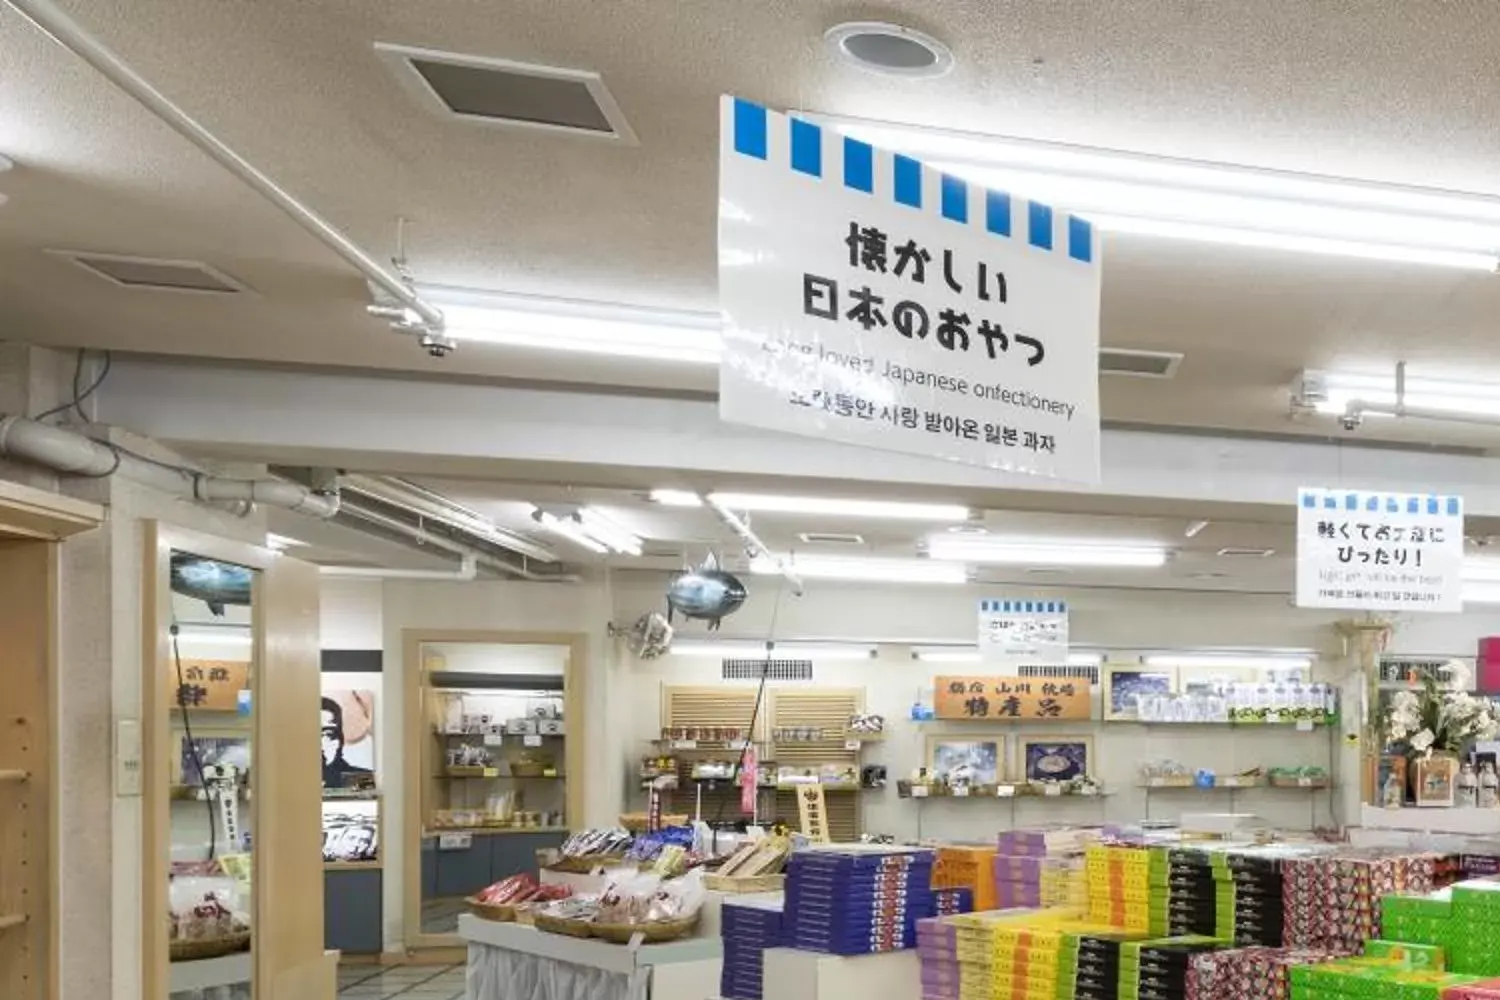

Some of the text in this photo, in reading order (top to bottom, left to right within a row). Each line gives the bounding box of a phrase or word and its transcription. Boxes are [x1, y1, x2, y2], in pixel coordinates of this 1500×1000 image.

[845, 221, 1008, 304] 懐かしい
[803, 273, 1045, 367] 日本のおやつ
[881, 359, 969, 395] Japanese
[880, 405, 919, 430] 사랑
[924, 411, 980, 437] 받아온
[984, 422, 1018, 445] 일본
[1023, 430, 1056, 455] 과자
